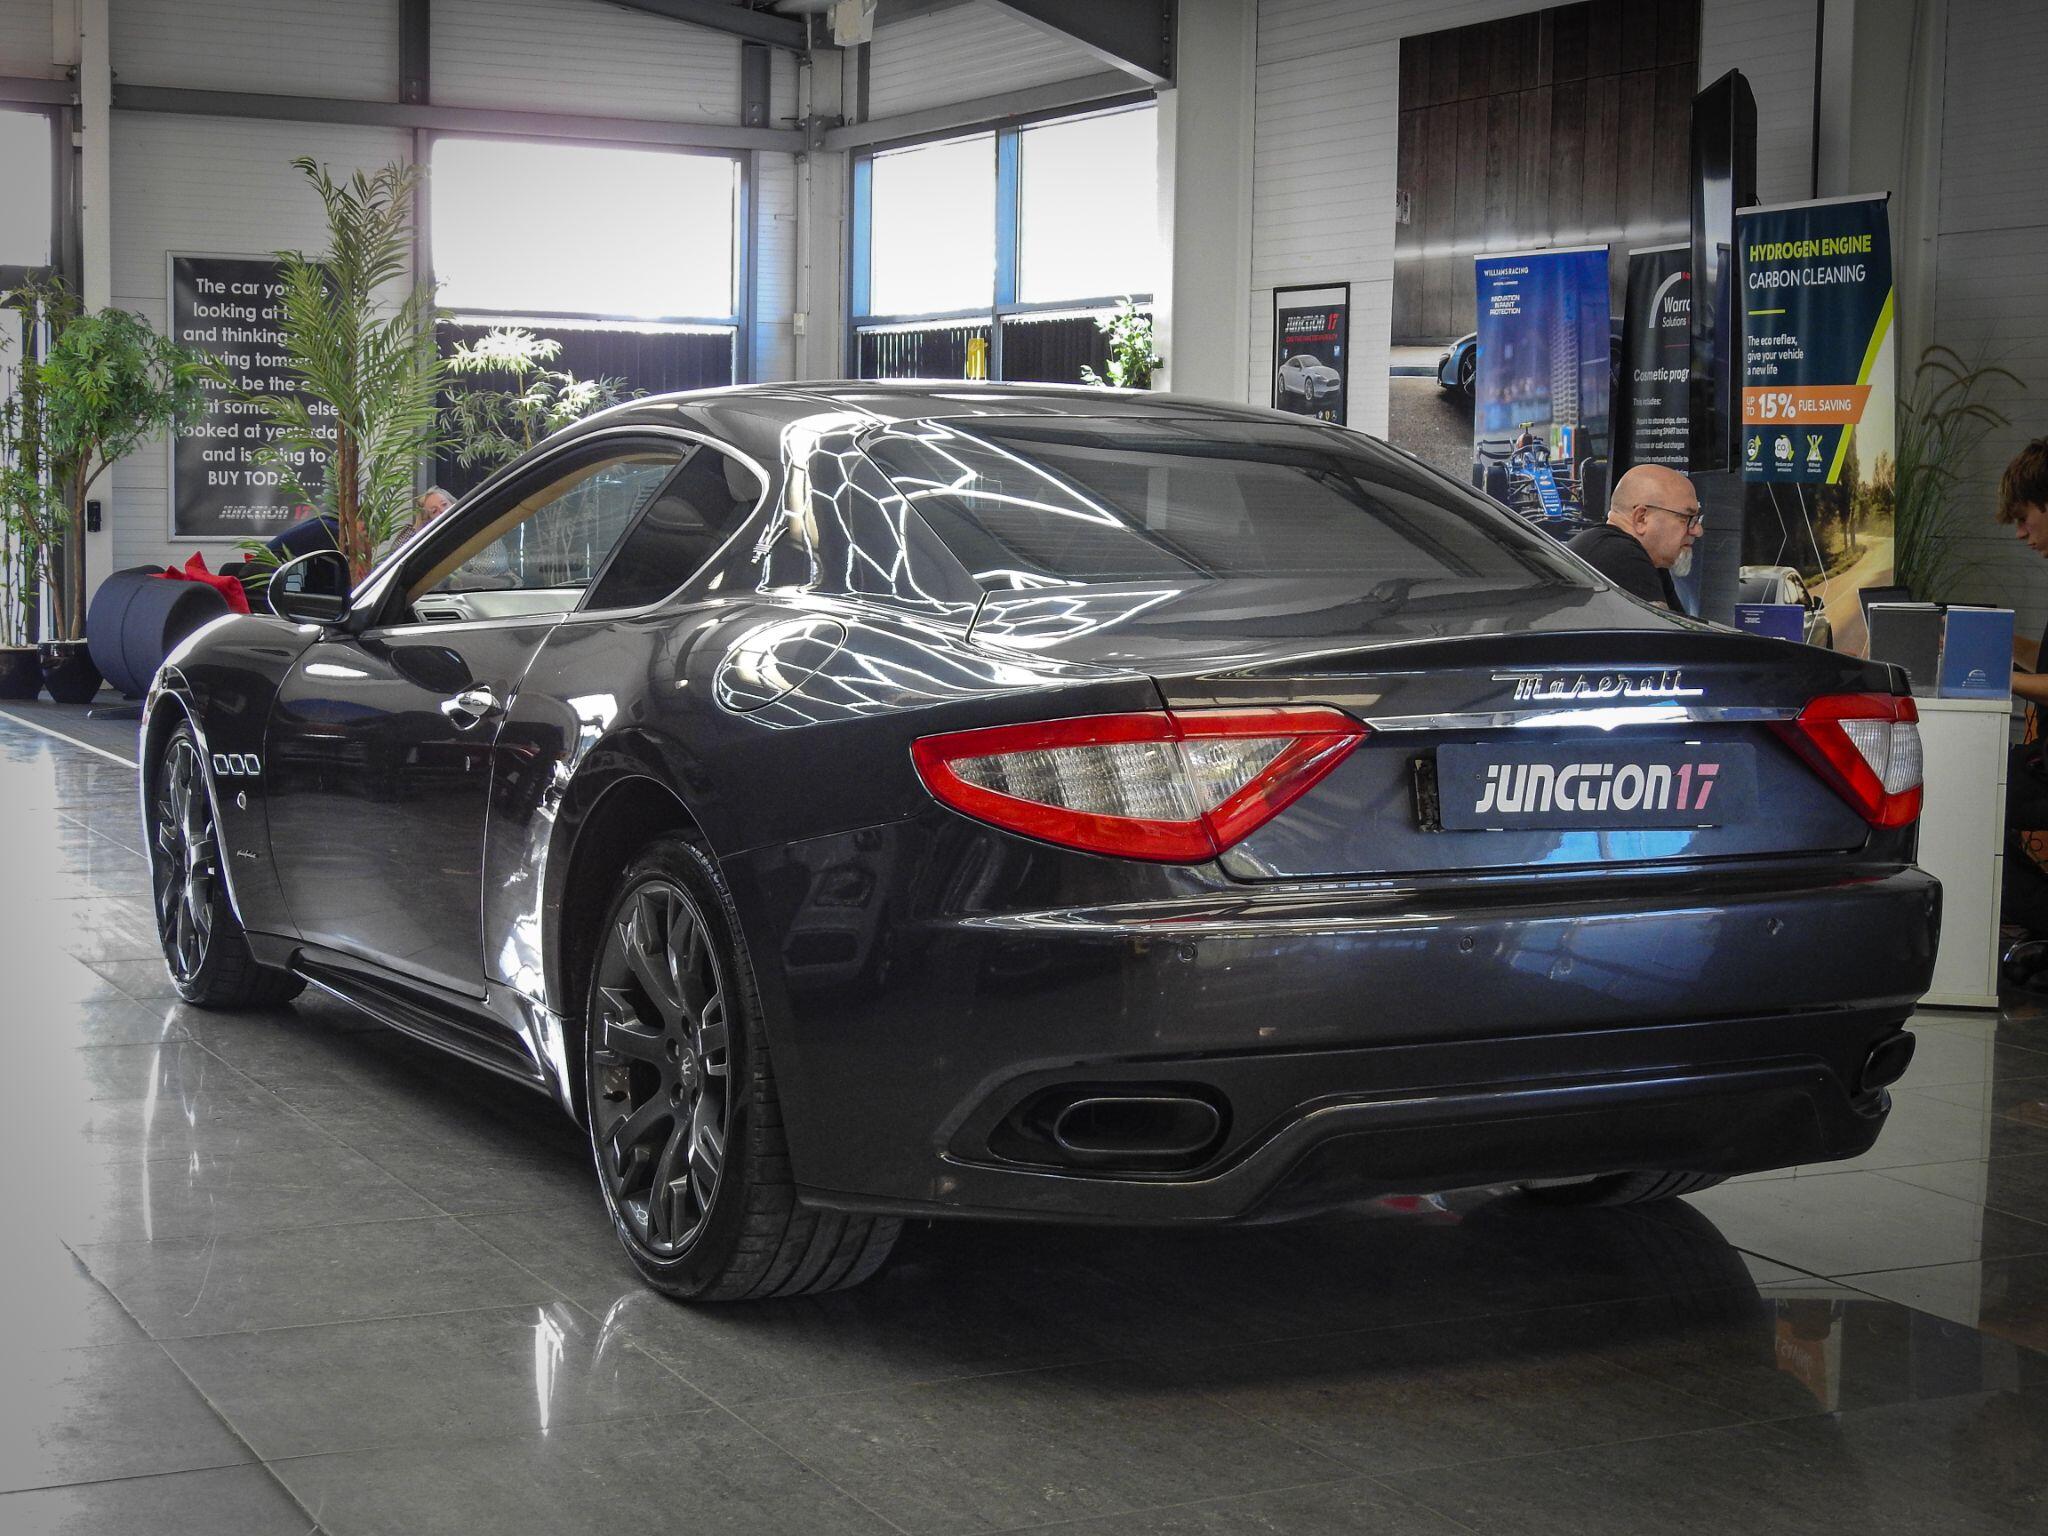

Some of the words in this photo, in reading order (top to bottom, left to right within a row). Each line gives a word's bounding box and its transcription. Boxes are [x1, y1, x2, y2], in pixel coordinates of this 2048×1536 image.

[1750, 239, 1820, 262] HYDROGEN
[1822, 234, 1872, 256] ENGINE
[1749, 268, 1800, 290] CARBON
[1803, 263, 1866, 286] CLEANING
[196, 278, 226, 294] The
[231, 282, 259, 295] car
[193, 302, 256, 322] looking
[262, 305, 278, 319] at
[1662, 316, 1687, 328] Solutions
[183, 327, 217, 341] and
[221, 327, 288, 347] thinking
[1748, 336, 1760, 346] The
[1760, 337, 1772, 346] eco
[1747, 350, 1761, 363] give
[1762, 352, 1777, 363] your
[1778, 348, 1804, 360] vehicle
[1633, 367, 1669, 382] Cosmetic
[1747, 367, 1752, 375] a
[1752, 367, 1766, 375] new
[1767, 363, 1778, 375] life
[242, 376, 265, 391] be
[269, 376, 295, 391] the
[1747, 396, 1755, 405] UP
[1759, 393, 1796, 418] 15%
[1798, 399, 1817, 412] FUEL
[1819, 399, 1852, 411] SAVING
[307, 401, 339, 416] else
[1747, 407, 1755, 416] TO
[244, 423, 261, 438] at
[202, 447, 235, 462] and
[240, 447, 253, 462] is
[310, 448, 326, 463] to
[208, 471, 240, 486] BUY
[1491, 670, 1704, 700] Maserati
